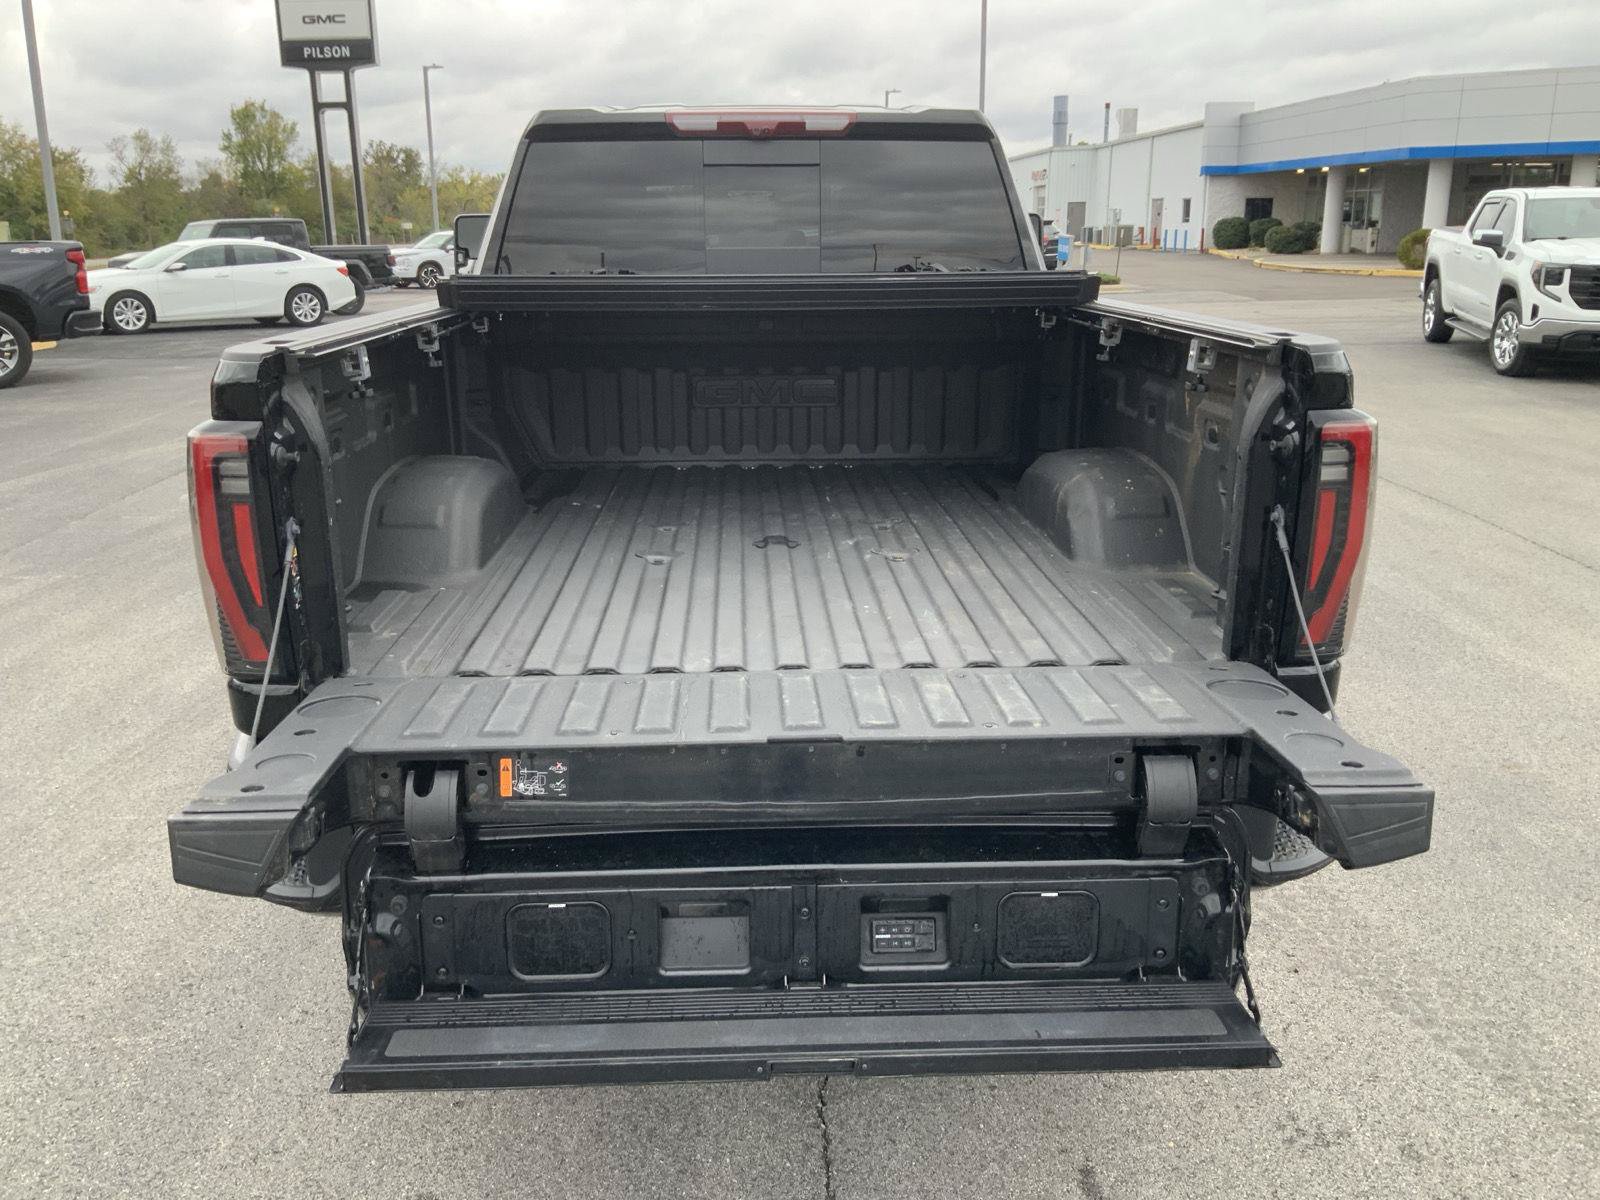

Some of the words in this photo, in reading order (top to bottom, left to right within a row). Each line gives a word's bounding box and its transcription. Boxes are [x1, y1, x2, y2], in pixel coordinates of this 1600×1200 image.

[302, 14, 346, 24] GMC
[303, 46, 351, 58] PILSON
[695, 378, 837, 406] GMC
